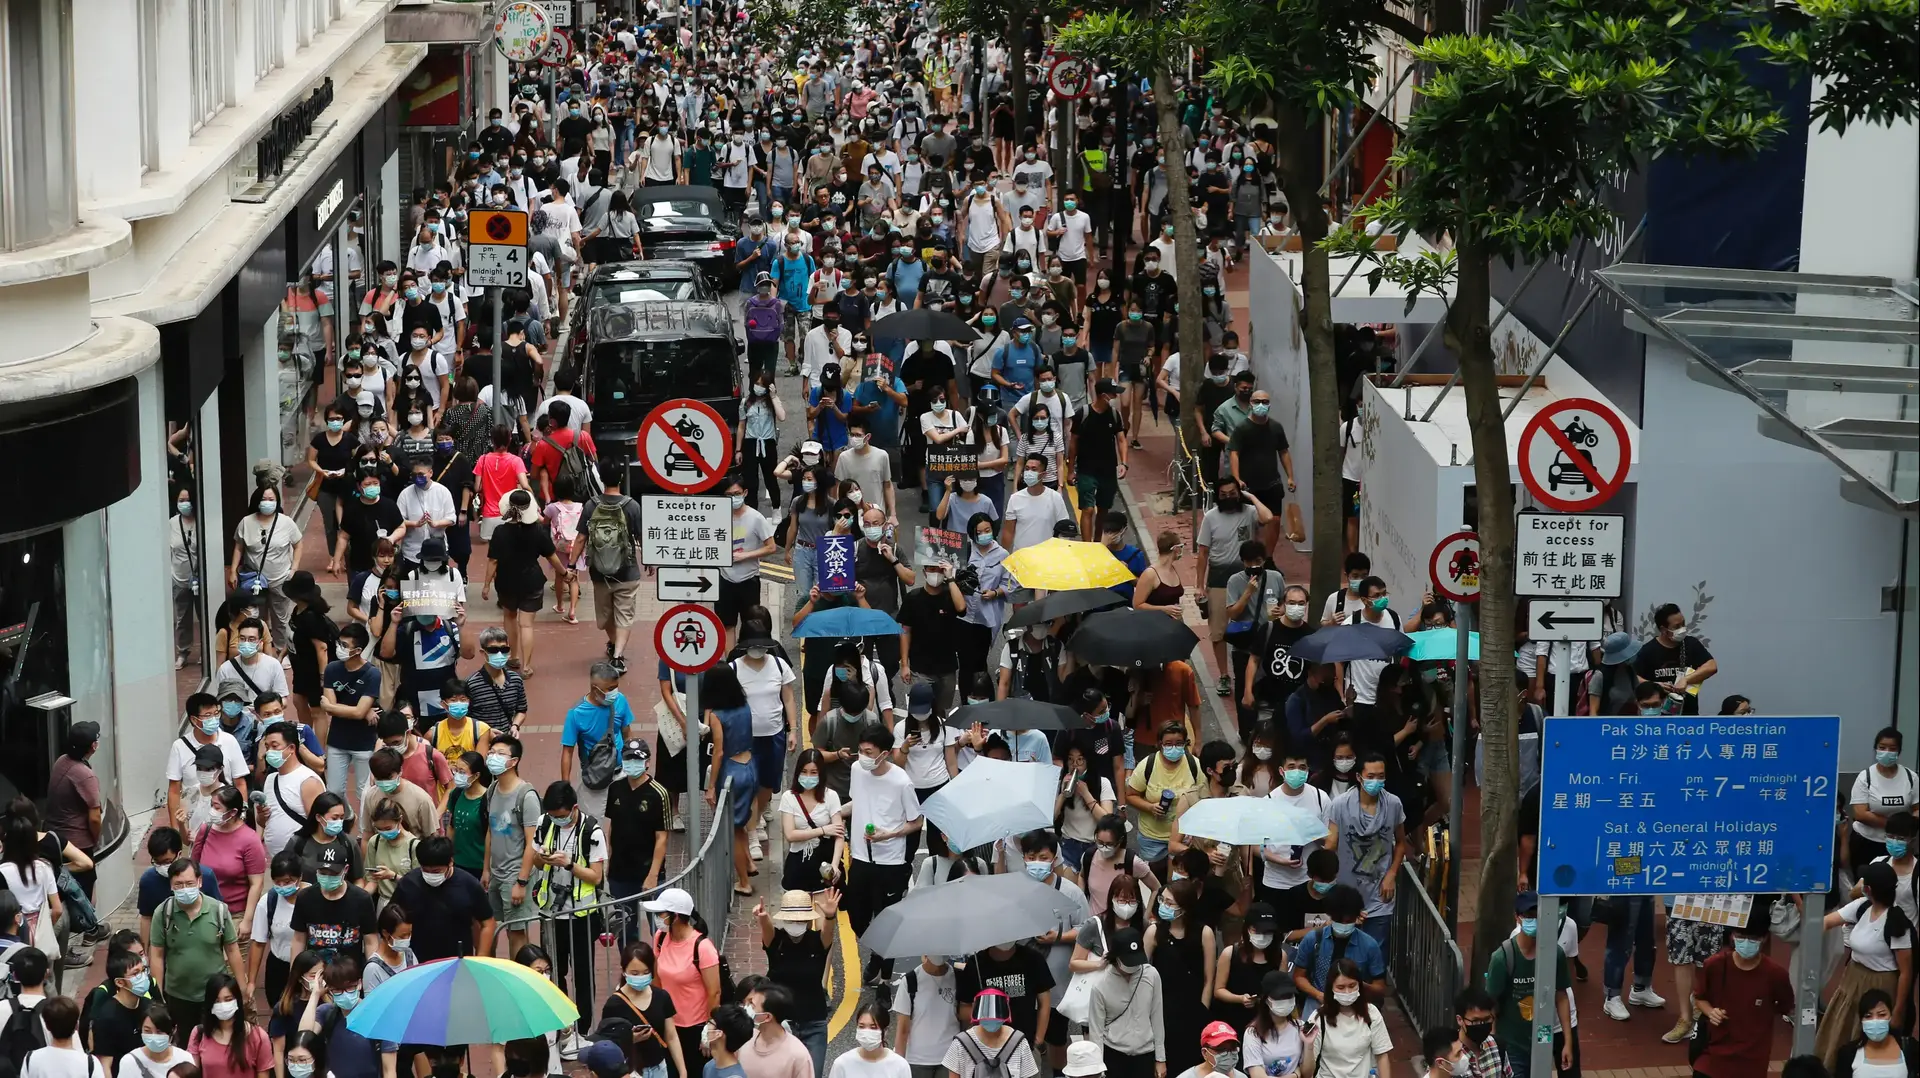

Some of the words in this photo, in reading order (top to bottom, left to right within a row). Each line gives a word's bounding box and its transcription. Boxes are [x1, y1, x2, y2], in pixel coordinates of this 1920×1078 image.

[478, 253, 497, 261] 下午
[506, 248, 518, 263] 4
[472, 267, 503, 275] midnight
[506, 271, 523, 285] 12
[657, 500, 697, 511] Except
[700, 501, 716, 510] for
[667, 514, 706, 522] access
[1532, 518, 1582, 532] Except
[1589, 519, 1609, 531] for
[647, 526, 727, 542] 前往此區者
[1546, 536, 1594, 546] access
[656, 545, 719, 560] 不在此限
[1523, 551, 1616, 568] 前往此區者
[1532, 573, 1606, 590] 不在此限
[1601, 724, 1628, 736] Pak
[1634, 723, 1662, 736] Sha
[1666, 723, 1704, 735] Road
[1710, 722, 1786, 735] Pedestrian
[1611, 743, 1779, 760] 白沙道行人專用區
[1569, 773, 1604, 785] Mon.
[1619, 773, 1641, 785] Fri.
[1686, 776, 1703, 785] pm
[1714, 776, 1728, 798] 7
[1749, 774, 1797, 785] midnight
[1803, 776, 1828, 797] 12
[1552, 793, 1656, 809] 星期一至五
[1680, 788, 1709, 802] 下午
[1759, 788, 1787, 801] 午夜
[1604, 822, 1633, 834] Sat.
[1637, 822, 1647, 834] &
[1653, 822, 1708, 834] General
[1714, 821, 1778, 835] Holidays
[1606, 840, 1774, 858] 星期六及公眾假期
[1642, 865, 1667, 886] 12
[1689, 861, 1738, 872] midnight
[1743, 863, 1768, 885] 12
[1607, 876, 1636, 889] 中午
[1699, 875, 1727, 888] 午夜
